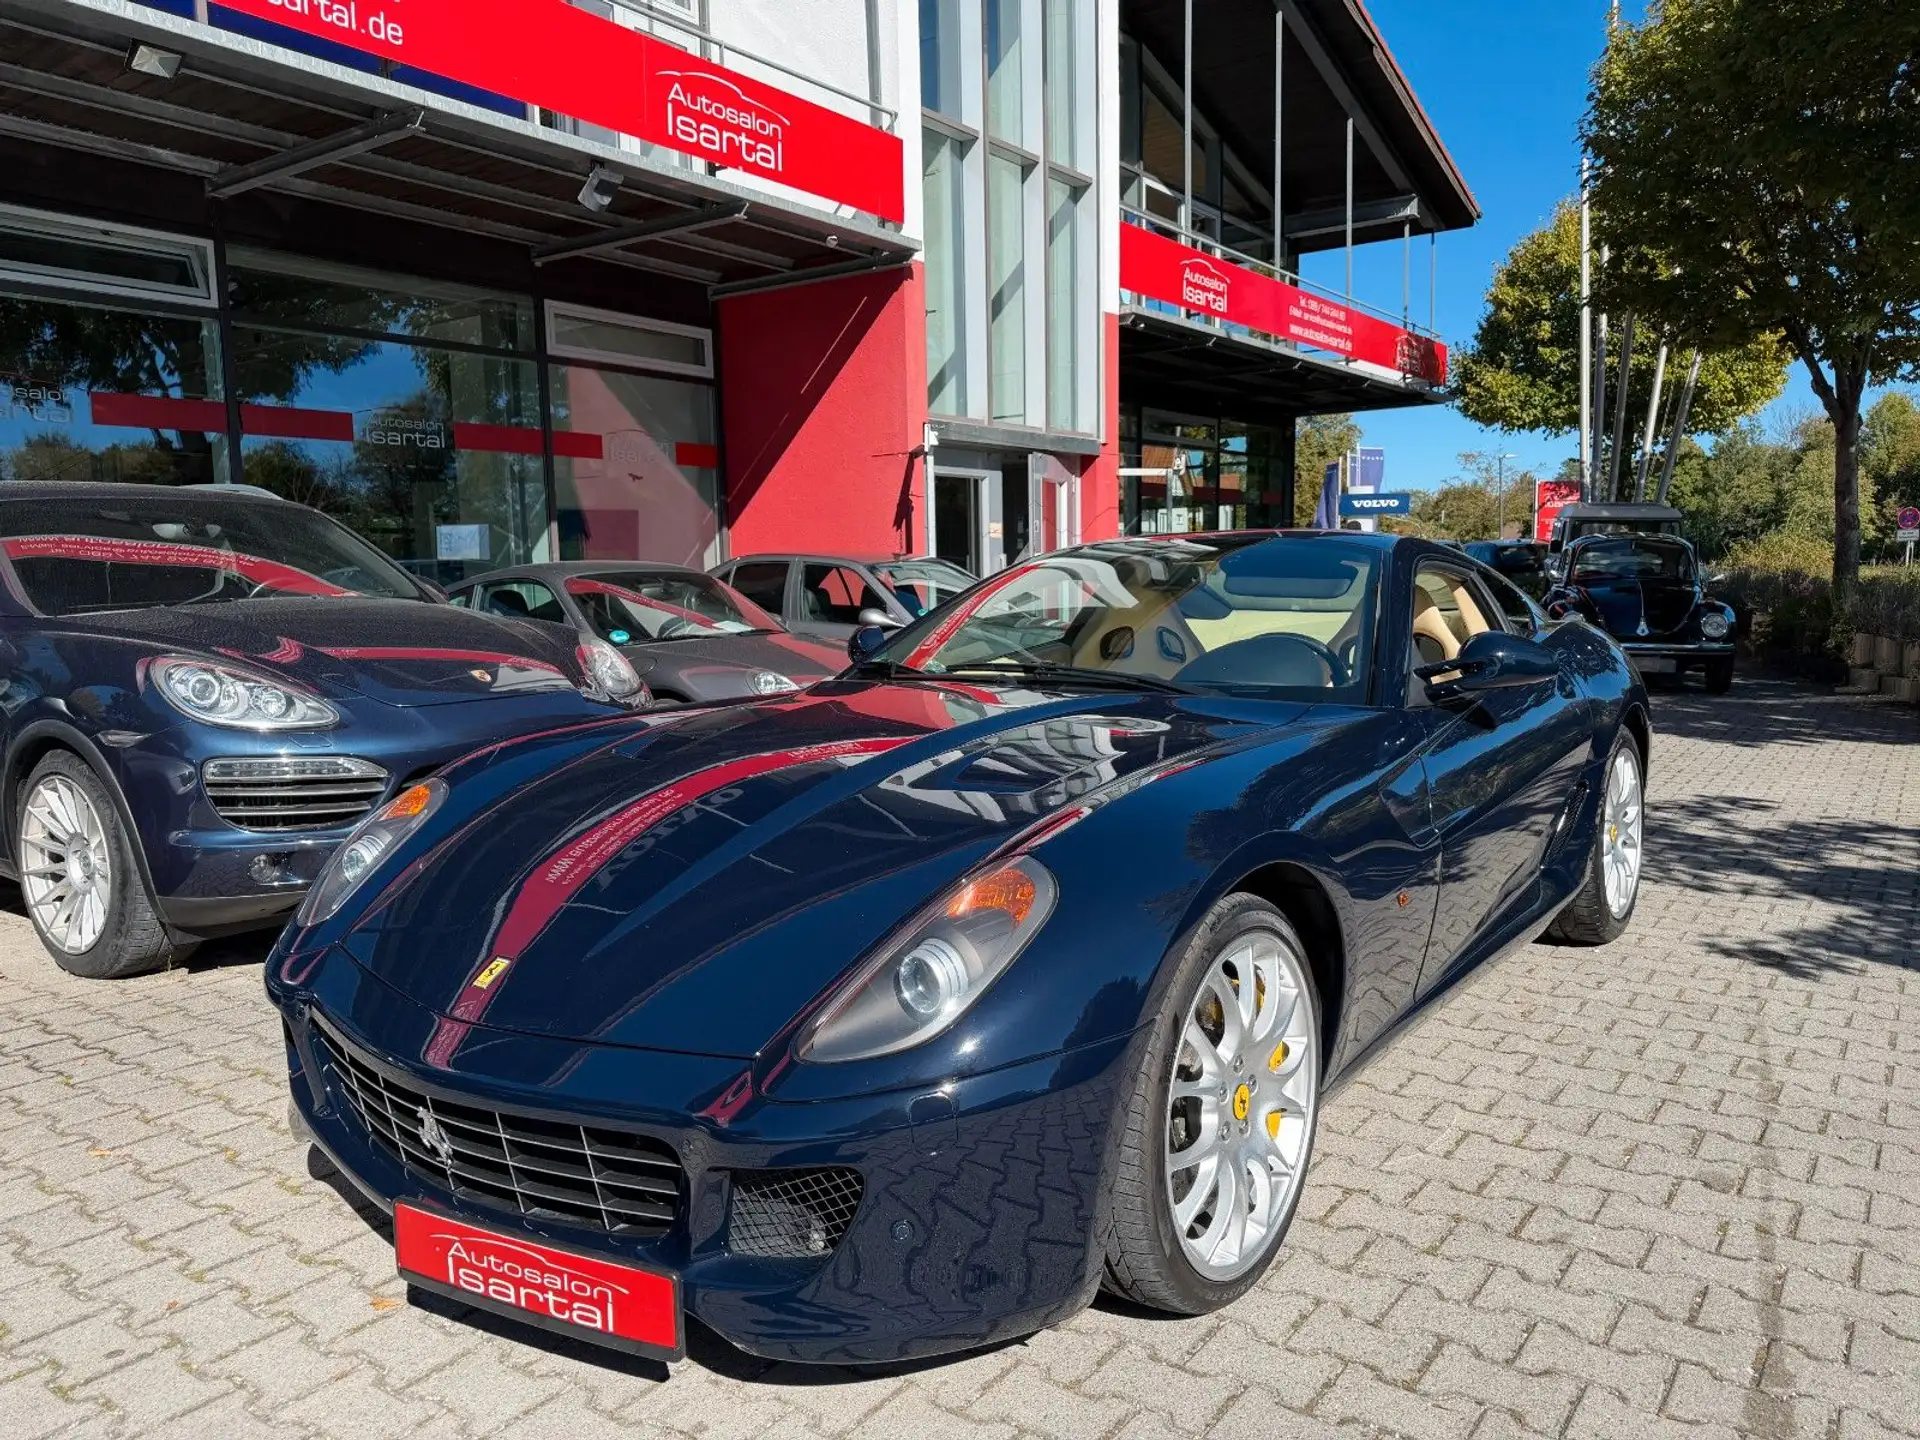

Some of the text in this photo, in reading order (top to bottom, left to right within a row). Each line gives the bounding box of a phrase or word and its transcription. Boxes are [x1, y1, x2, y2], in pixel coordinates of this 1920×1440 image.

[668, 82, 782, 140] Autosalon
[667, 101, 783, 172] Isartal
[1183, 280, 1227, 313] Isartal
[1184, 267, 1227, 292] Autosalon
[366, 427, 446, 448] Isartal
[1351, 499, 1400, 508] VOLVO
[447, 1253, 615, 1332] Isartal
[448, 1241, 613, 1304] Autosalon
